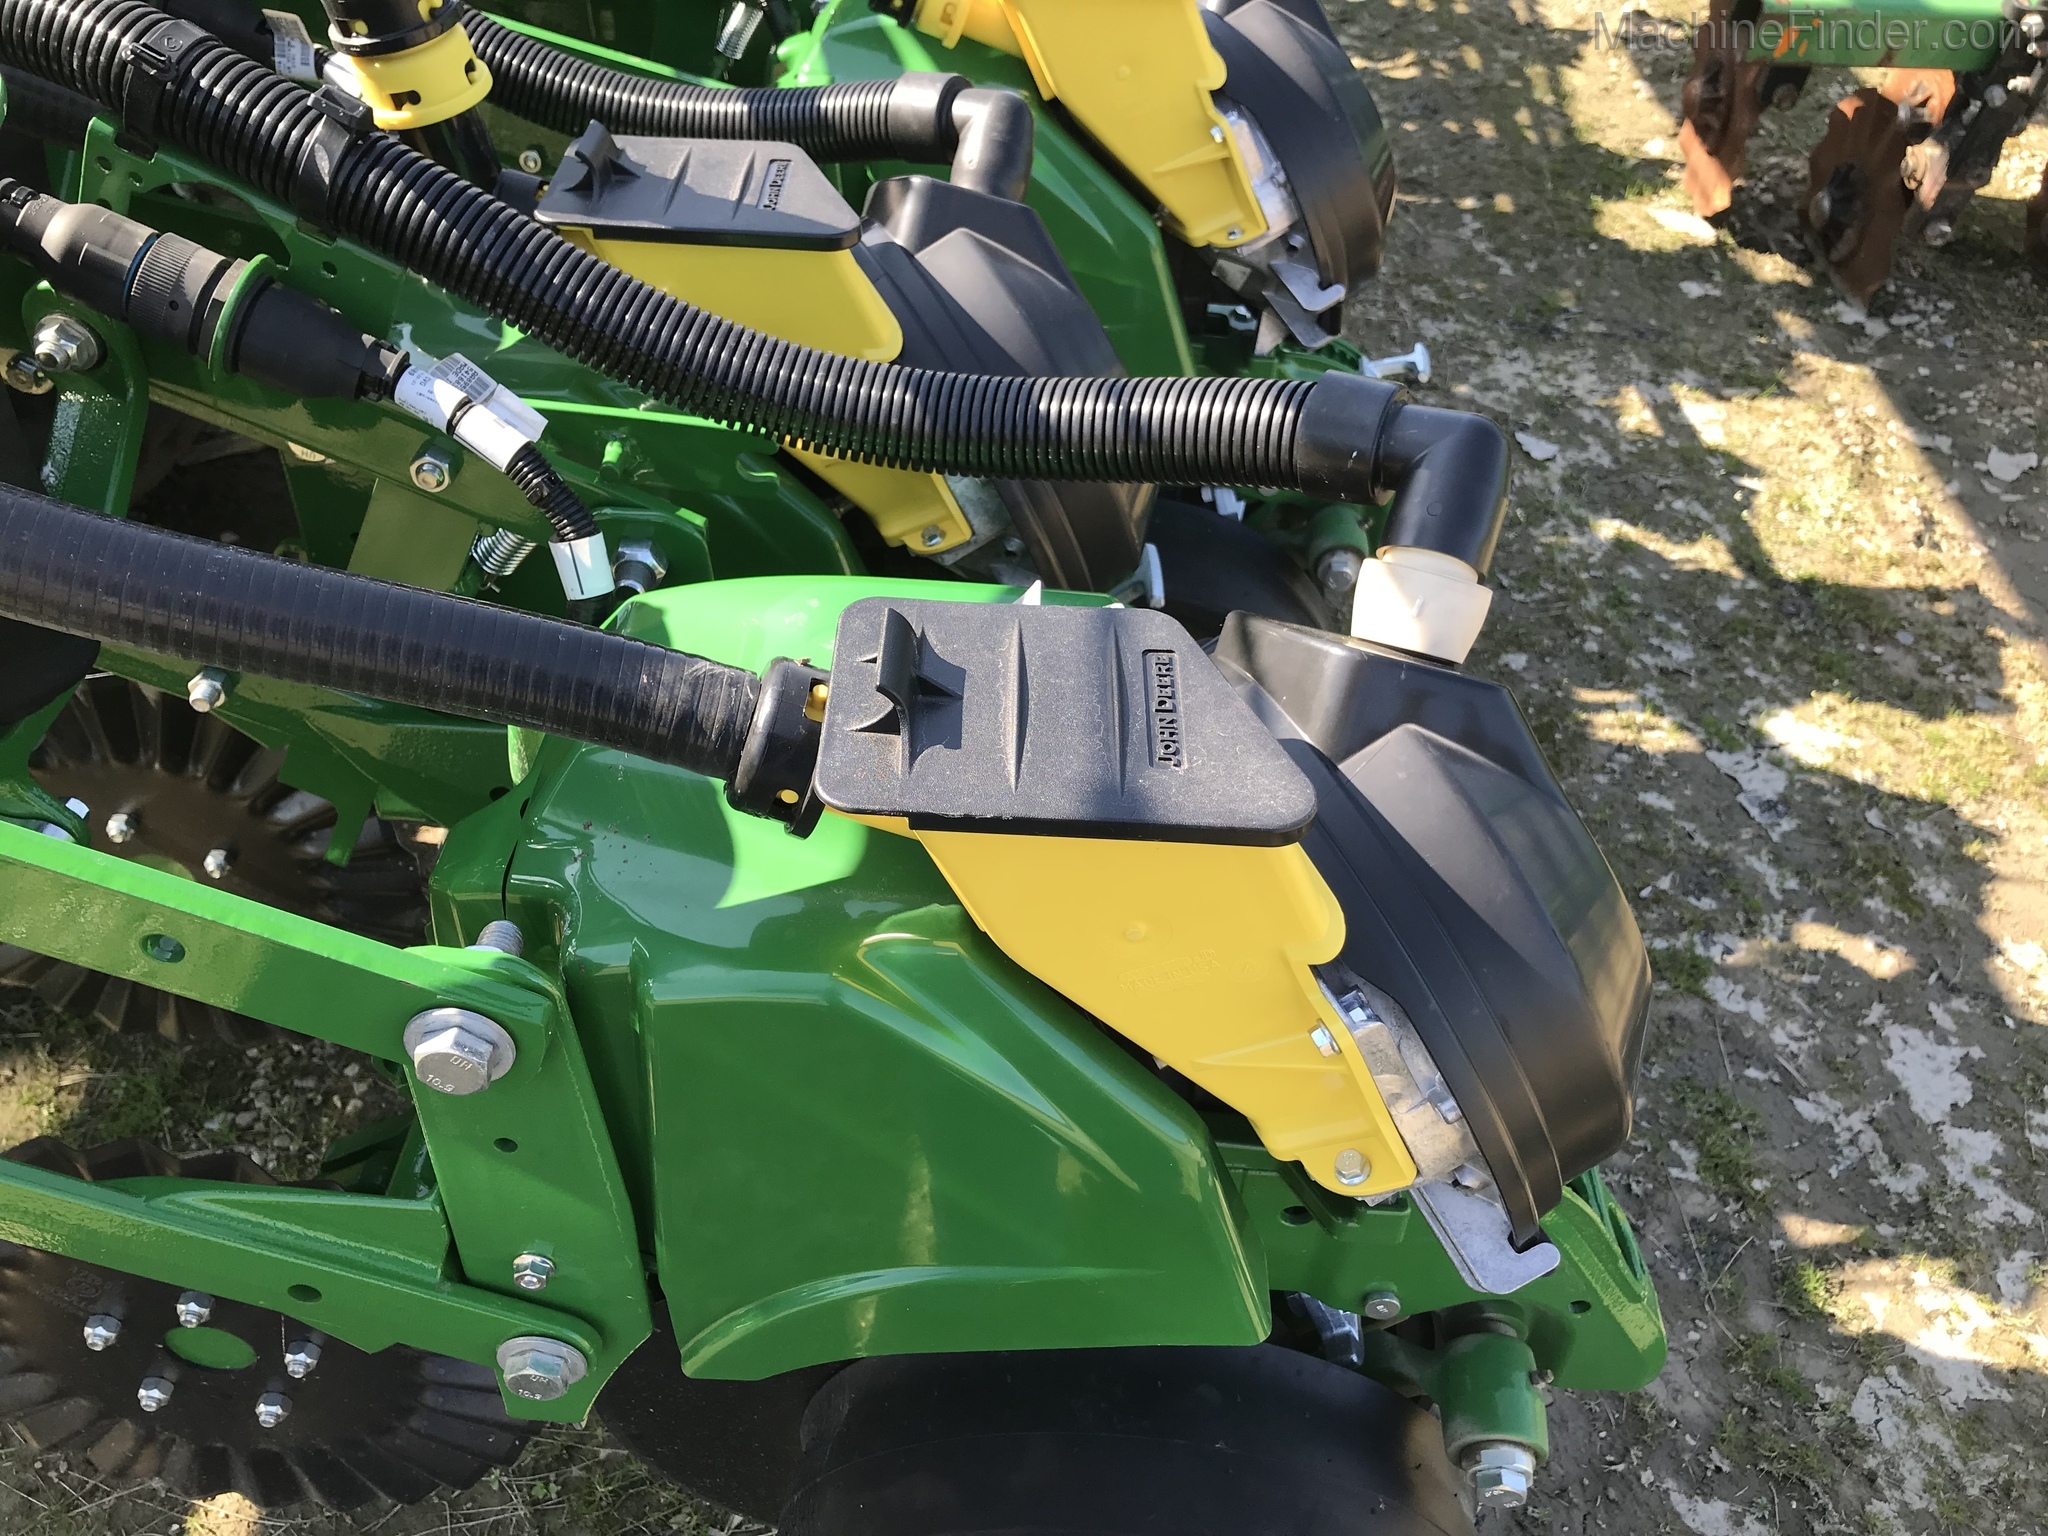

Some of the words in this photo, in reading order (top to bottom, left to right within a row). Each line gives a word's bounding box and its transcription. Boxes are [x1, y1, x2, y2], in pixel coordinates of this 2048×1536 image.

[769, 164, 788, 187] DEERE
[763, 188, 780, 211] JOHN
[1154, 654, 1177, 712] DEERE
[1157, 717, 1181, 768] JOHN
